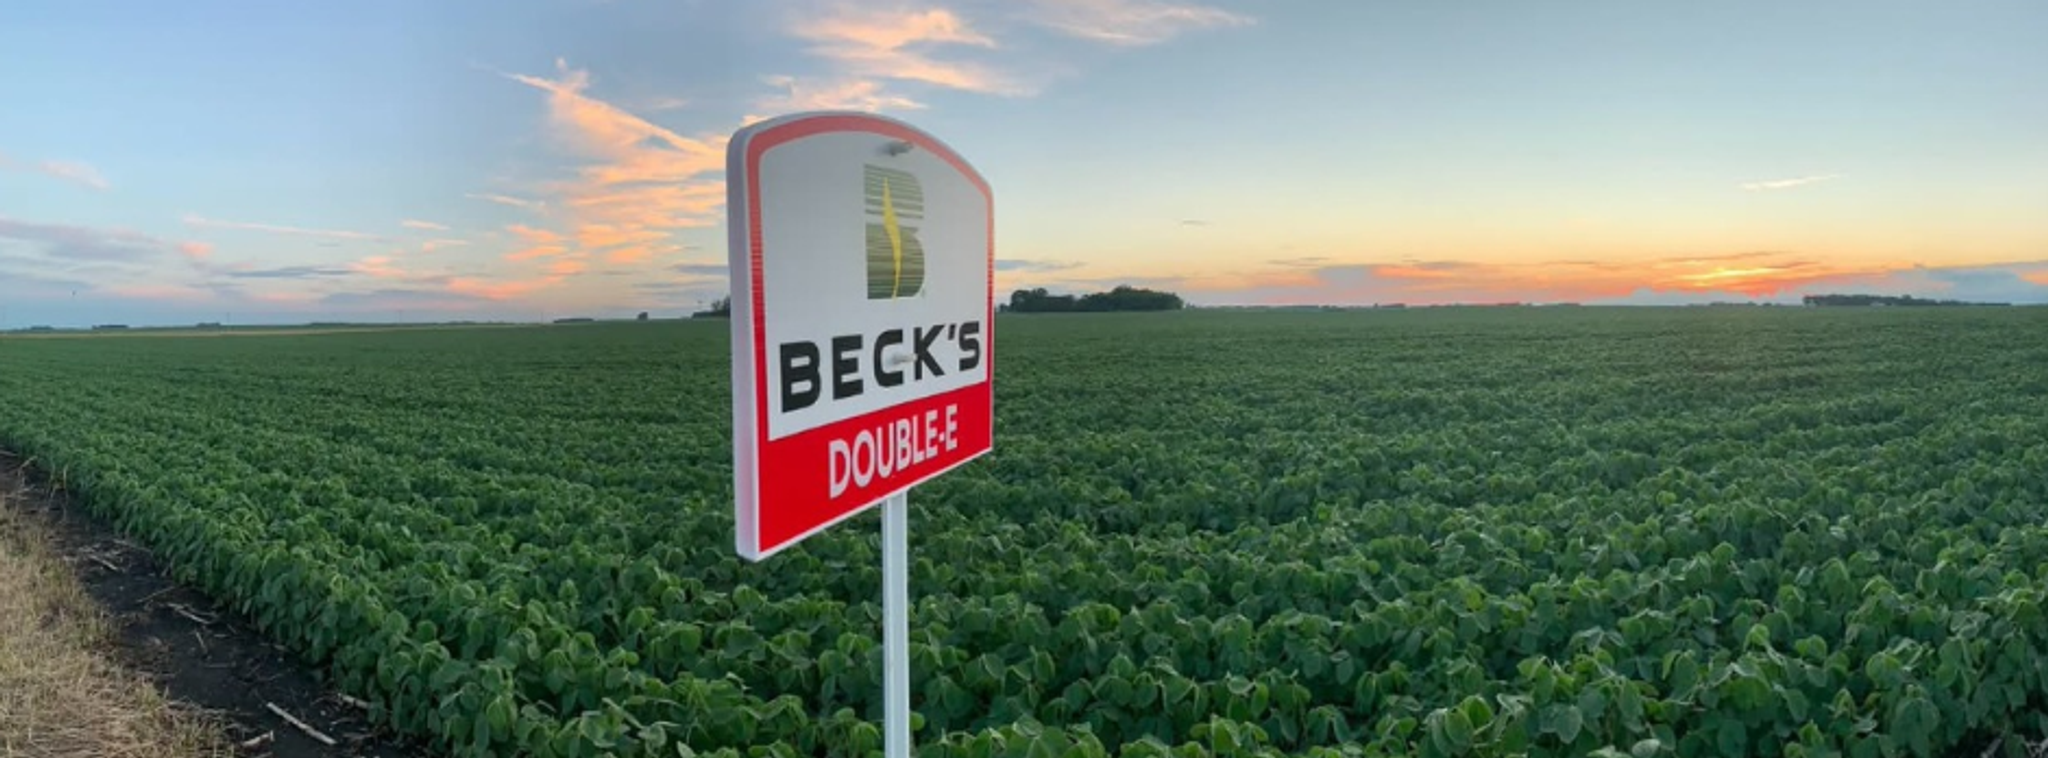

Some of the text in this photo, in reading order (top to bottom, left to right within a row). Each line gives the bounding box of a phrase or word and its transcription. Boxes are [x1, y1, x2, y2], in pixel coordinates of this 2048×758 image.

[864, 164, 925, 299] B
[779, 320, 981, 413] BECK'S
[828, 403, 958, 500] DOUBLE-E
